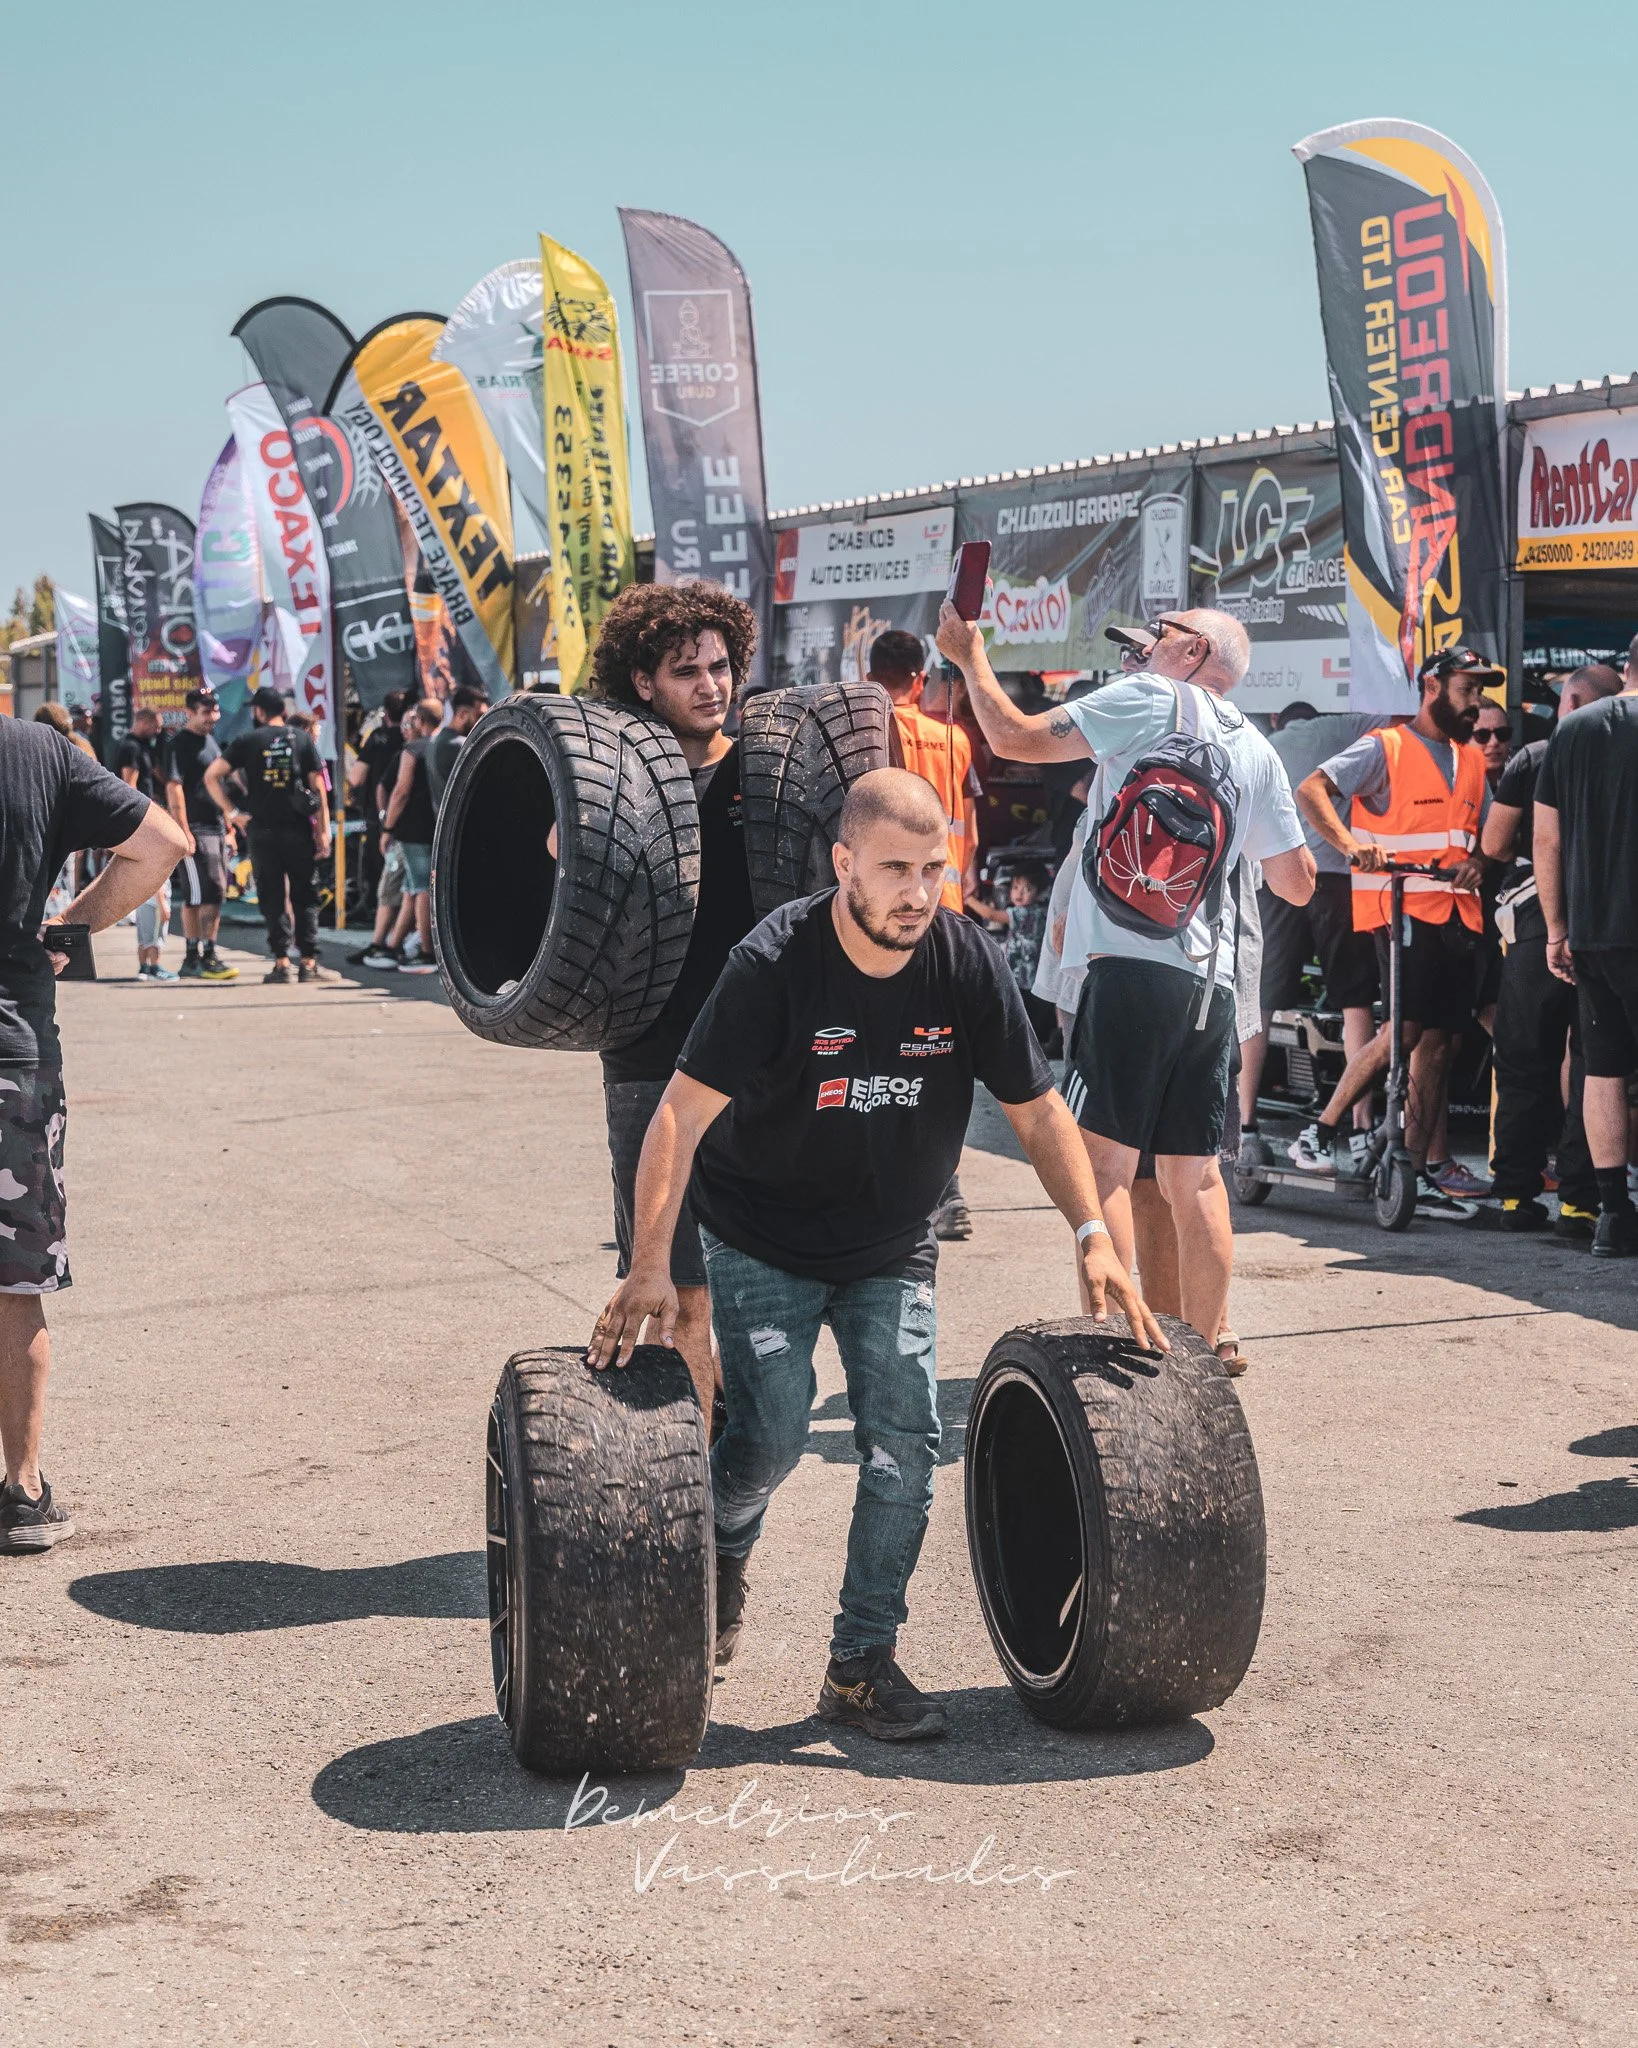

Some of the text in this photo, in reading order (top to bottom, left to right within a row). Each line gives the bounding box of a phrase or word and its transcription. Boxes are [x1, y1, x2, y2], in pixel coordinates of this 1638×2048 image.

[1582, 540, 1634, 562] 24200499
[808, 565, 843, 586] AUTO
[845, 559, 910, 583] SERVICES
[1285, 557, 1346, 588] GARAGE
[899, 1040, 955, 1051] PSALTI
[820, 1087, 844, 1099] ENEOS
[894, 1094, 919, 1108] OIL
